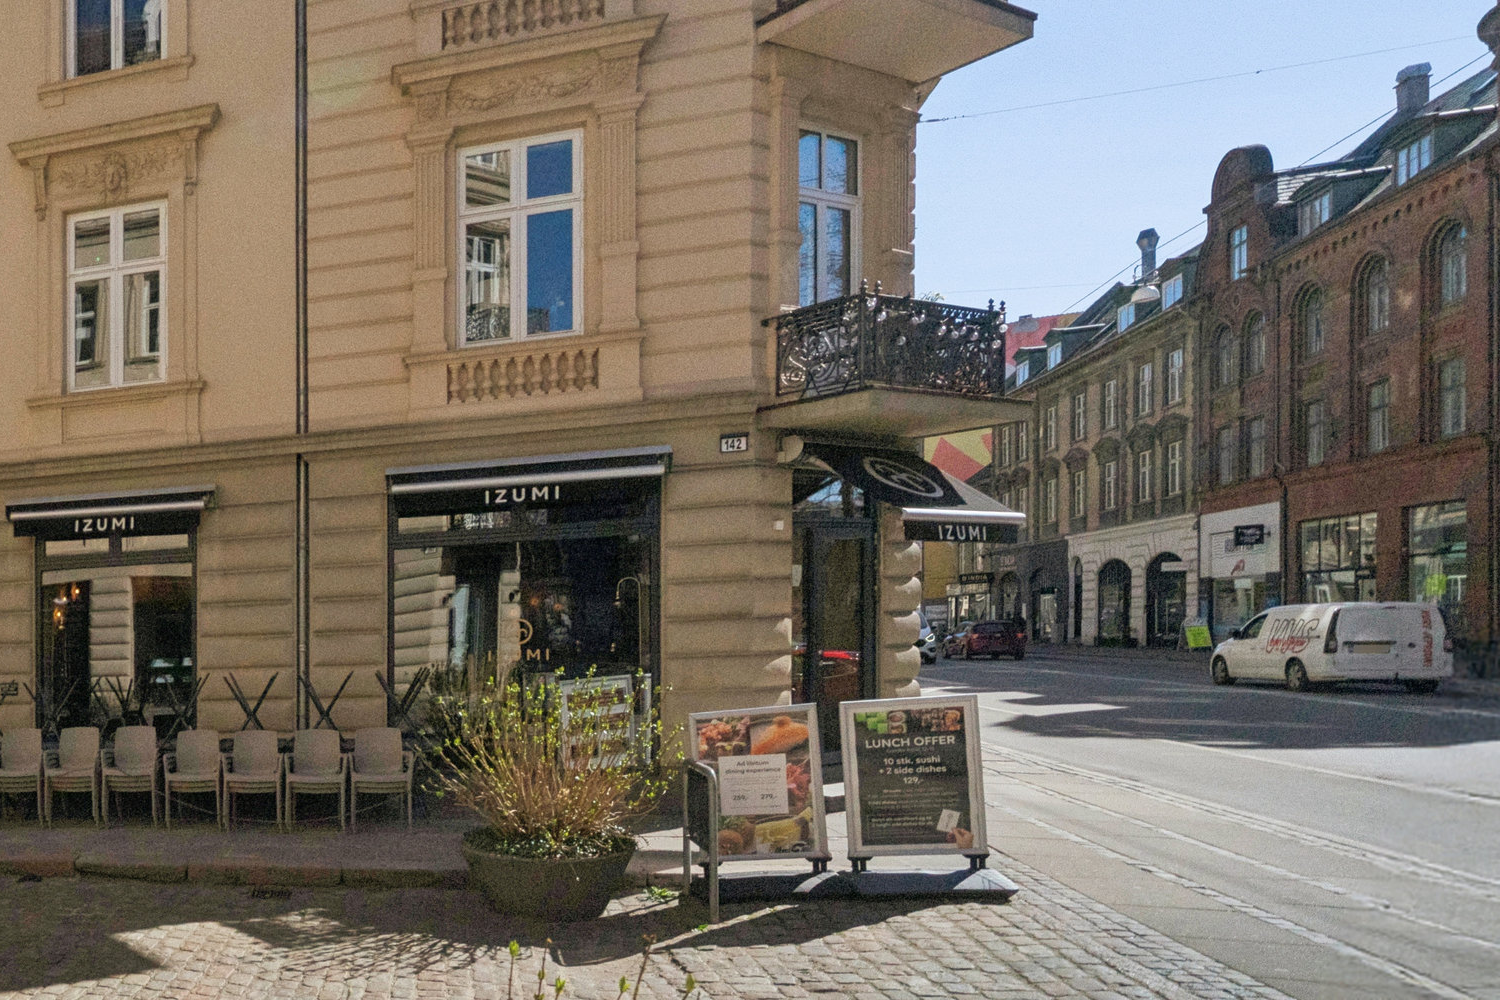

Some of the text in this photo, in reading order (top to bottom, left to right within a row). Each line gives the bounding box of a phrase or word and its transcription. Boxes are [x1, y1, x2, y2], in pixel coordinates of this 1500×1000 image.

[724, 438, 742, 451] 142
[484, 485, 560, 505] IZUMI
[74, 516, 135, 533] IZUMI
[938, 524, 987, 541] IZUMI
[487, 647, 550, 662] IMI
[865, 735, 956, 749] LUNCH OFFER
[883, 755, 941, 765] 10 stk. sushi
[886, 767, 892, 775] 2
[894, 766, 914, 774] side
[916, 764, 947, 774] dishes
